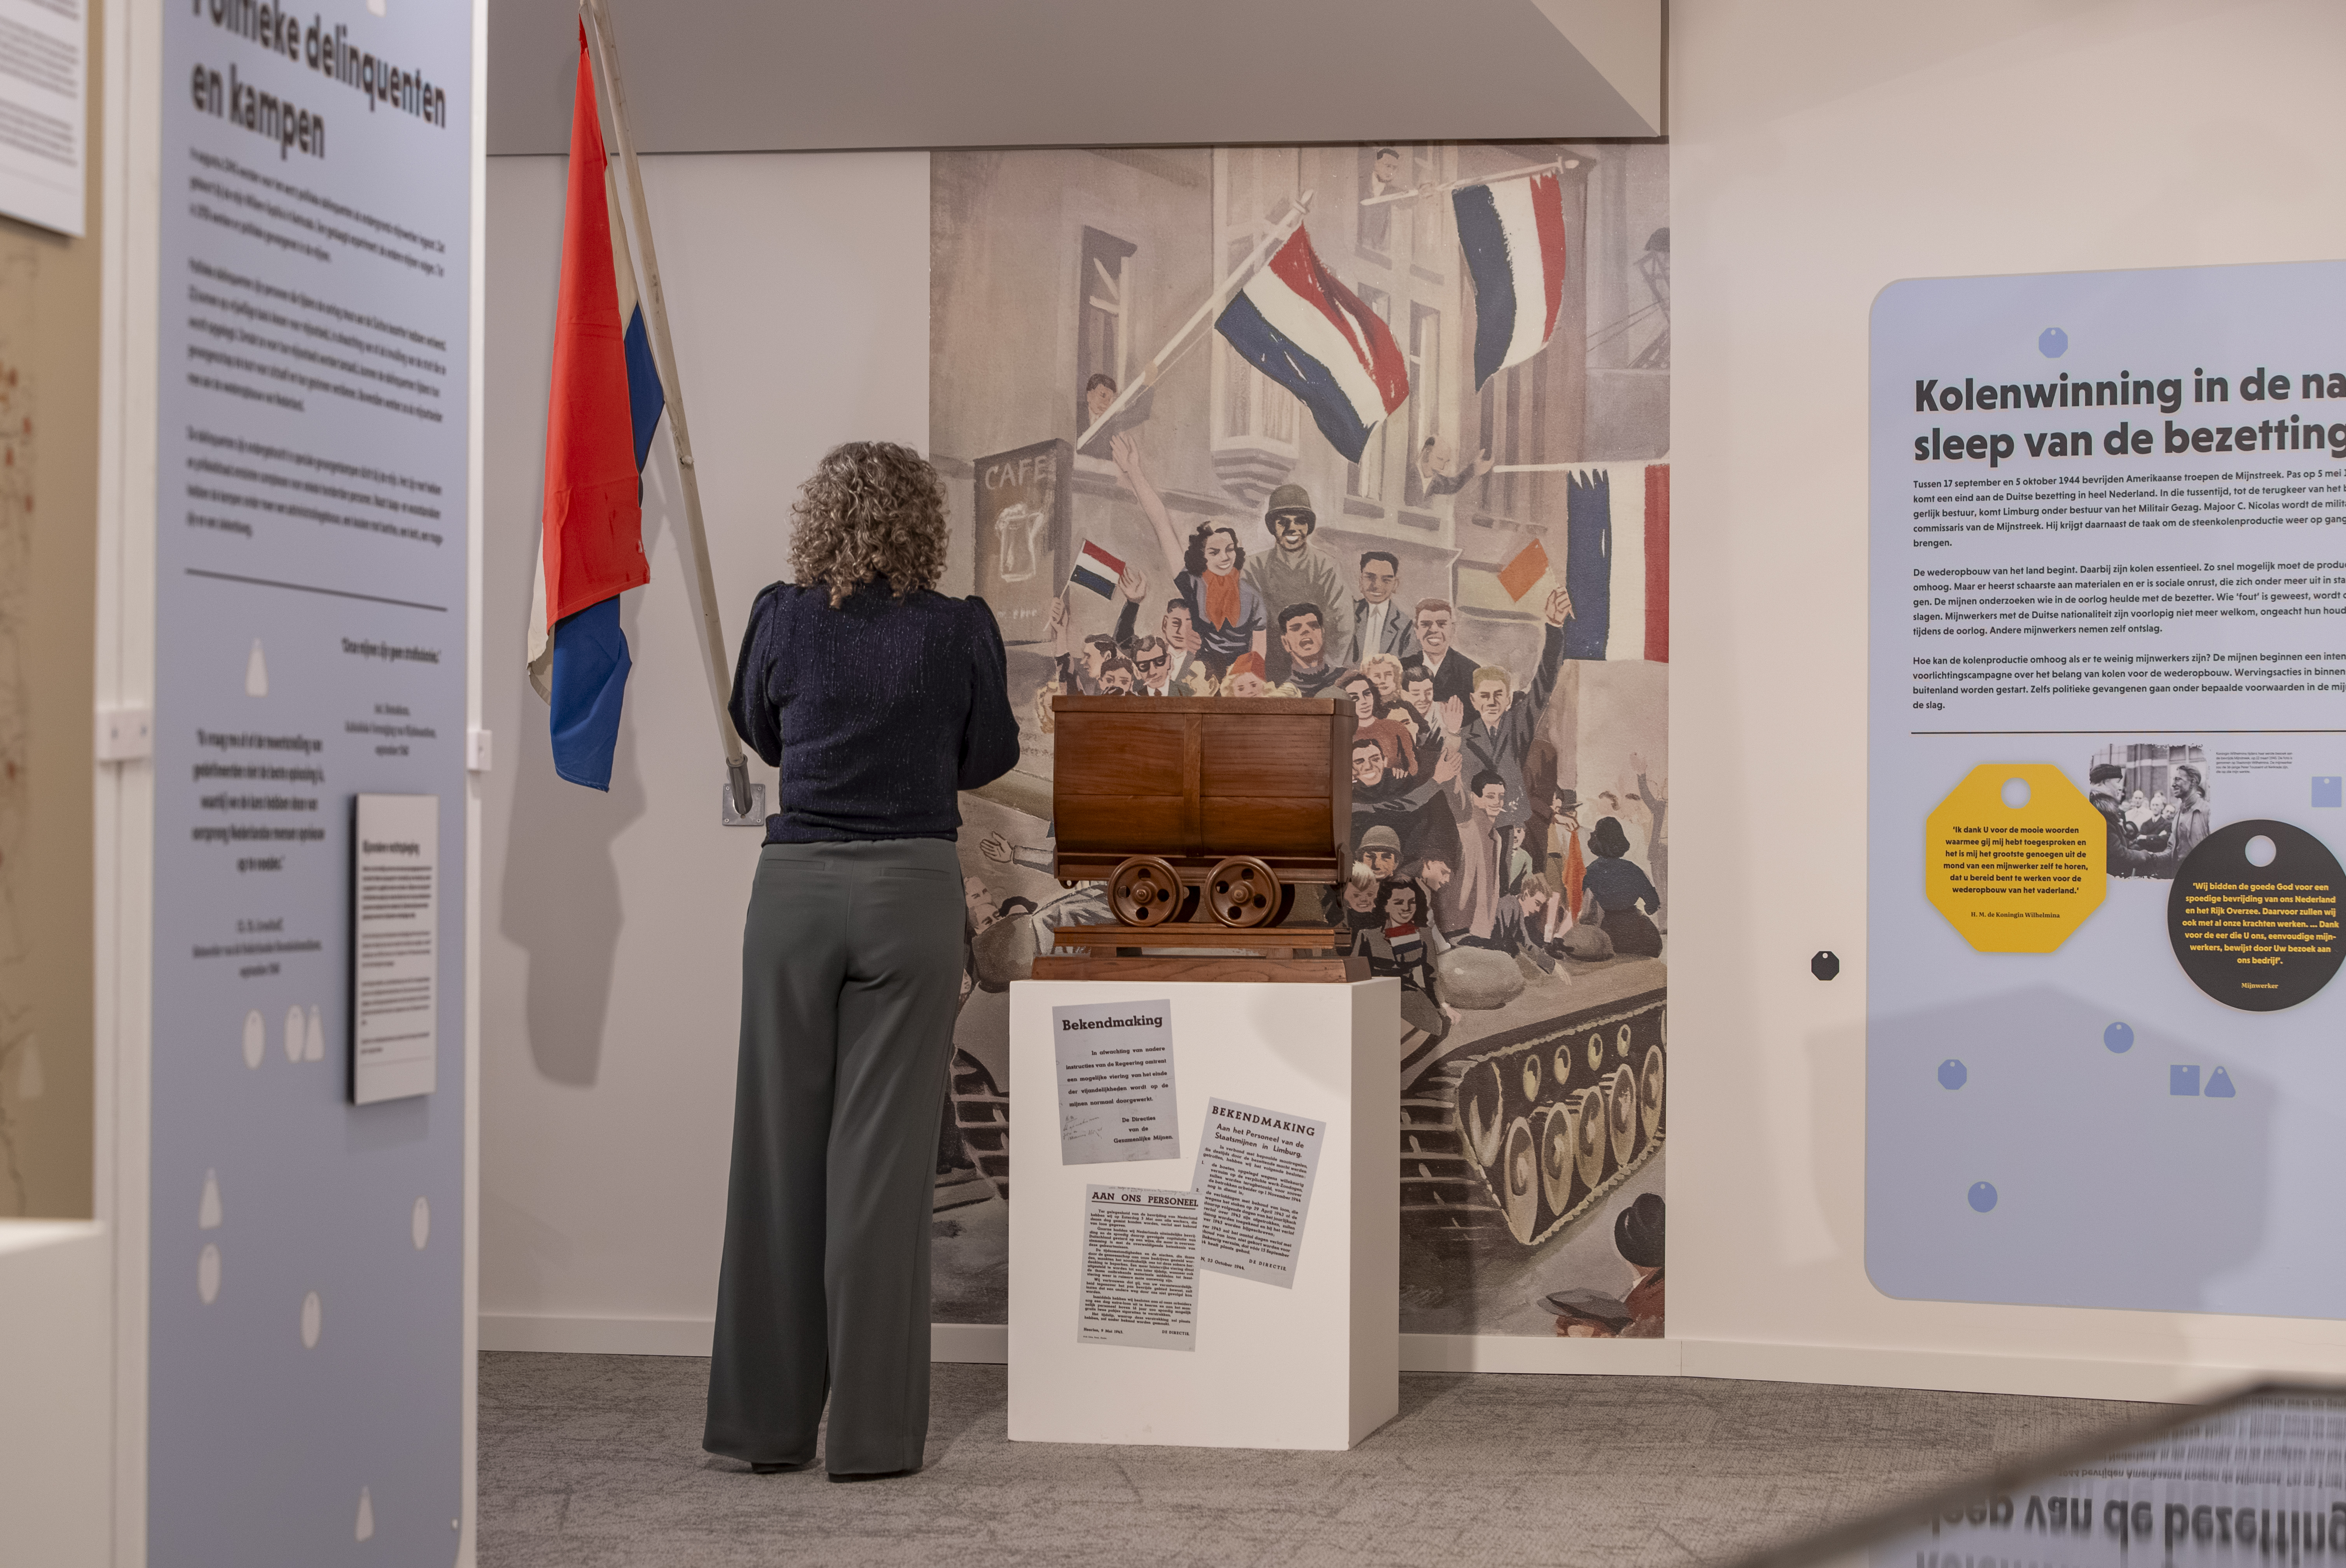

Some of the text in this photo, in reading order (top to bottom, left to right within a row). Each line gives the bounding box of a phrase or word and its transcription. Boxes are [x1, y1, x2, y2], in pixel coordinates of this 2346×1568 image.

[305, 14, 446, 129] delinquenten
[190, 62, 325, 161] en kampen
[1916, 370, 2182, 414] Kolenwinning
[2194, 367, 2228, 403] in
[2240, 367, 2290, 401] de
[1915, 414, 2346, 468] sleep van de bezetting
[985, 455, 1046, 490] CAFE
[1944, 479, 1953, 487] 17
[1955, 478, 2001, 489] september
[2023, 477, 2057, 485] oktober
[2059, 476, 2080, 484] 1944
[2082, 475, 2124, 485] bevrijden
[2126, 474, 2182, 483] Amerikaanse
[2184, 474, 2219, 483] troepen
[2236, 471, 2284, 482] Mijnstreek.
[2303, 471, 2315, 480] op
[2325, 469, 2341, 477] mei
[1927, 567, 1991, 578] wederopbouw
[2047, 566, 2077, 576] begint.
[2080, 565, 2111, 575] Daarbij
[2113, 564, 2128, 574] zijn
[2130, 564, 2154, 572] kolen
[2156, 563, 2201, 572] essentieel.
[2237, 562, 2275, 572] mogelijk
[2303, 561, 2315, 569] de
[1981, 838, 1990, 847] gij
[1992, 838, 2004, 847] mij
[2024, 838, 2075, 847] toegesproken
[2250, 883, 2276, 892] goede
[2185, 894, 2222, 904] spoedige
[2223, 894, 2263, 904] bevrijding
[1062, 1015, 1162, 1031] Bekendmaking
[1081, 1086, 1127, 1095] vijandelijkheden
[1212, 1105, 1315, 1136] BEKENDMAKING
[1216, 1123, 1230, 1132] Aan
[1233, 1126, 1244, 1135] het
[1246, 1129, 1279, 1143] Personeel
[1215, 1132, 1257, 1147] Staatsmijnen
[1273, 1145, 1302, 1158] Limburg.
[1256, 1153, 1277, 1161] bepaalde
[1092, 1192, 1198, 1207] AAN ONS PERSONEEL
